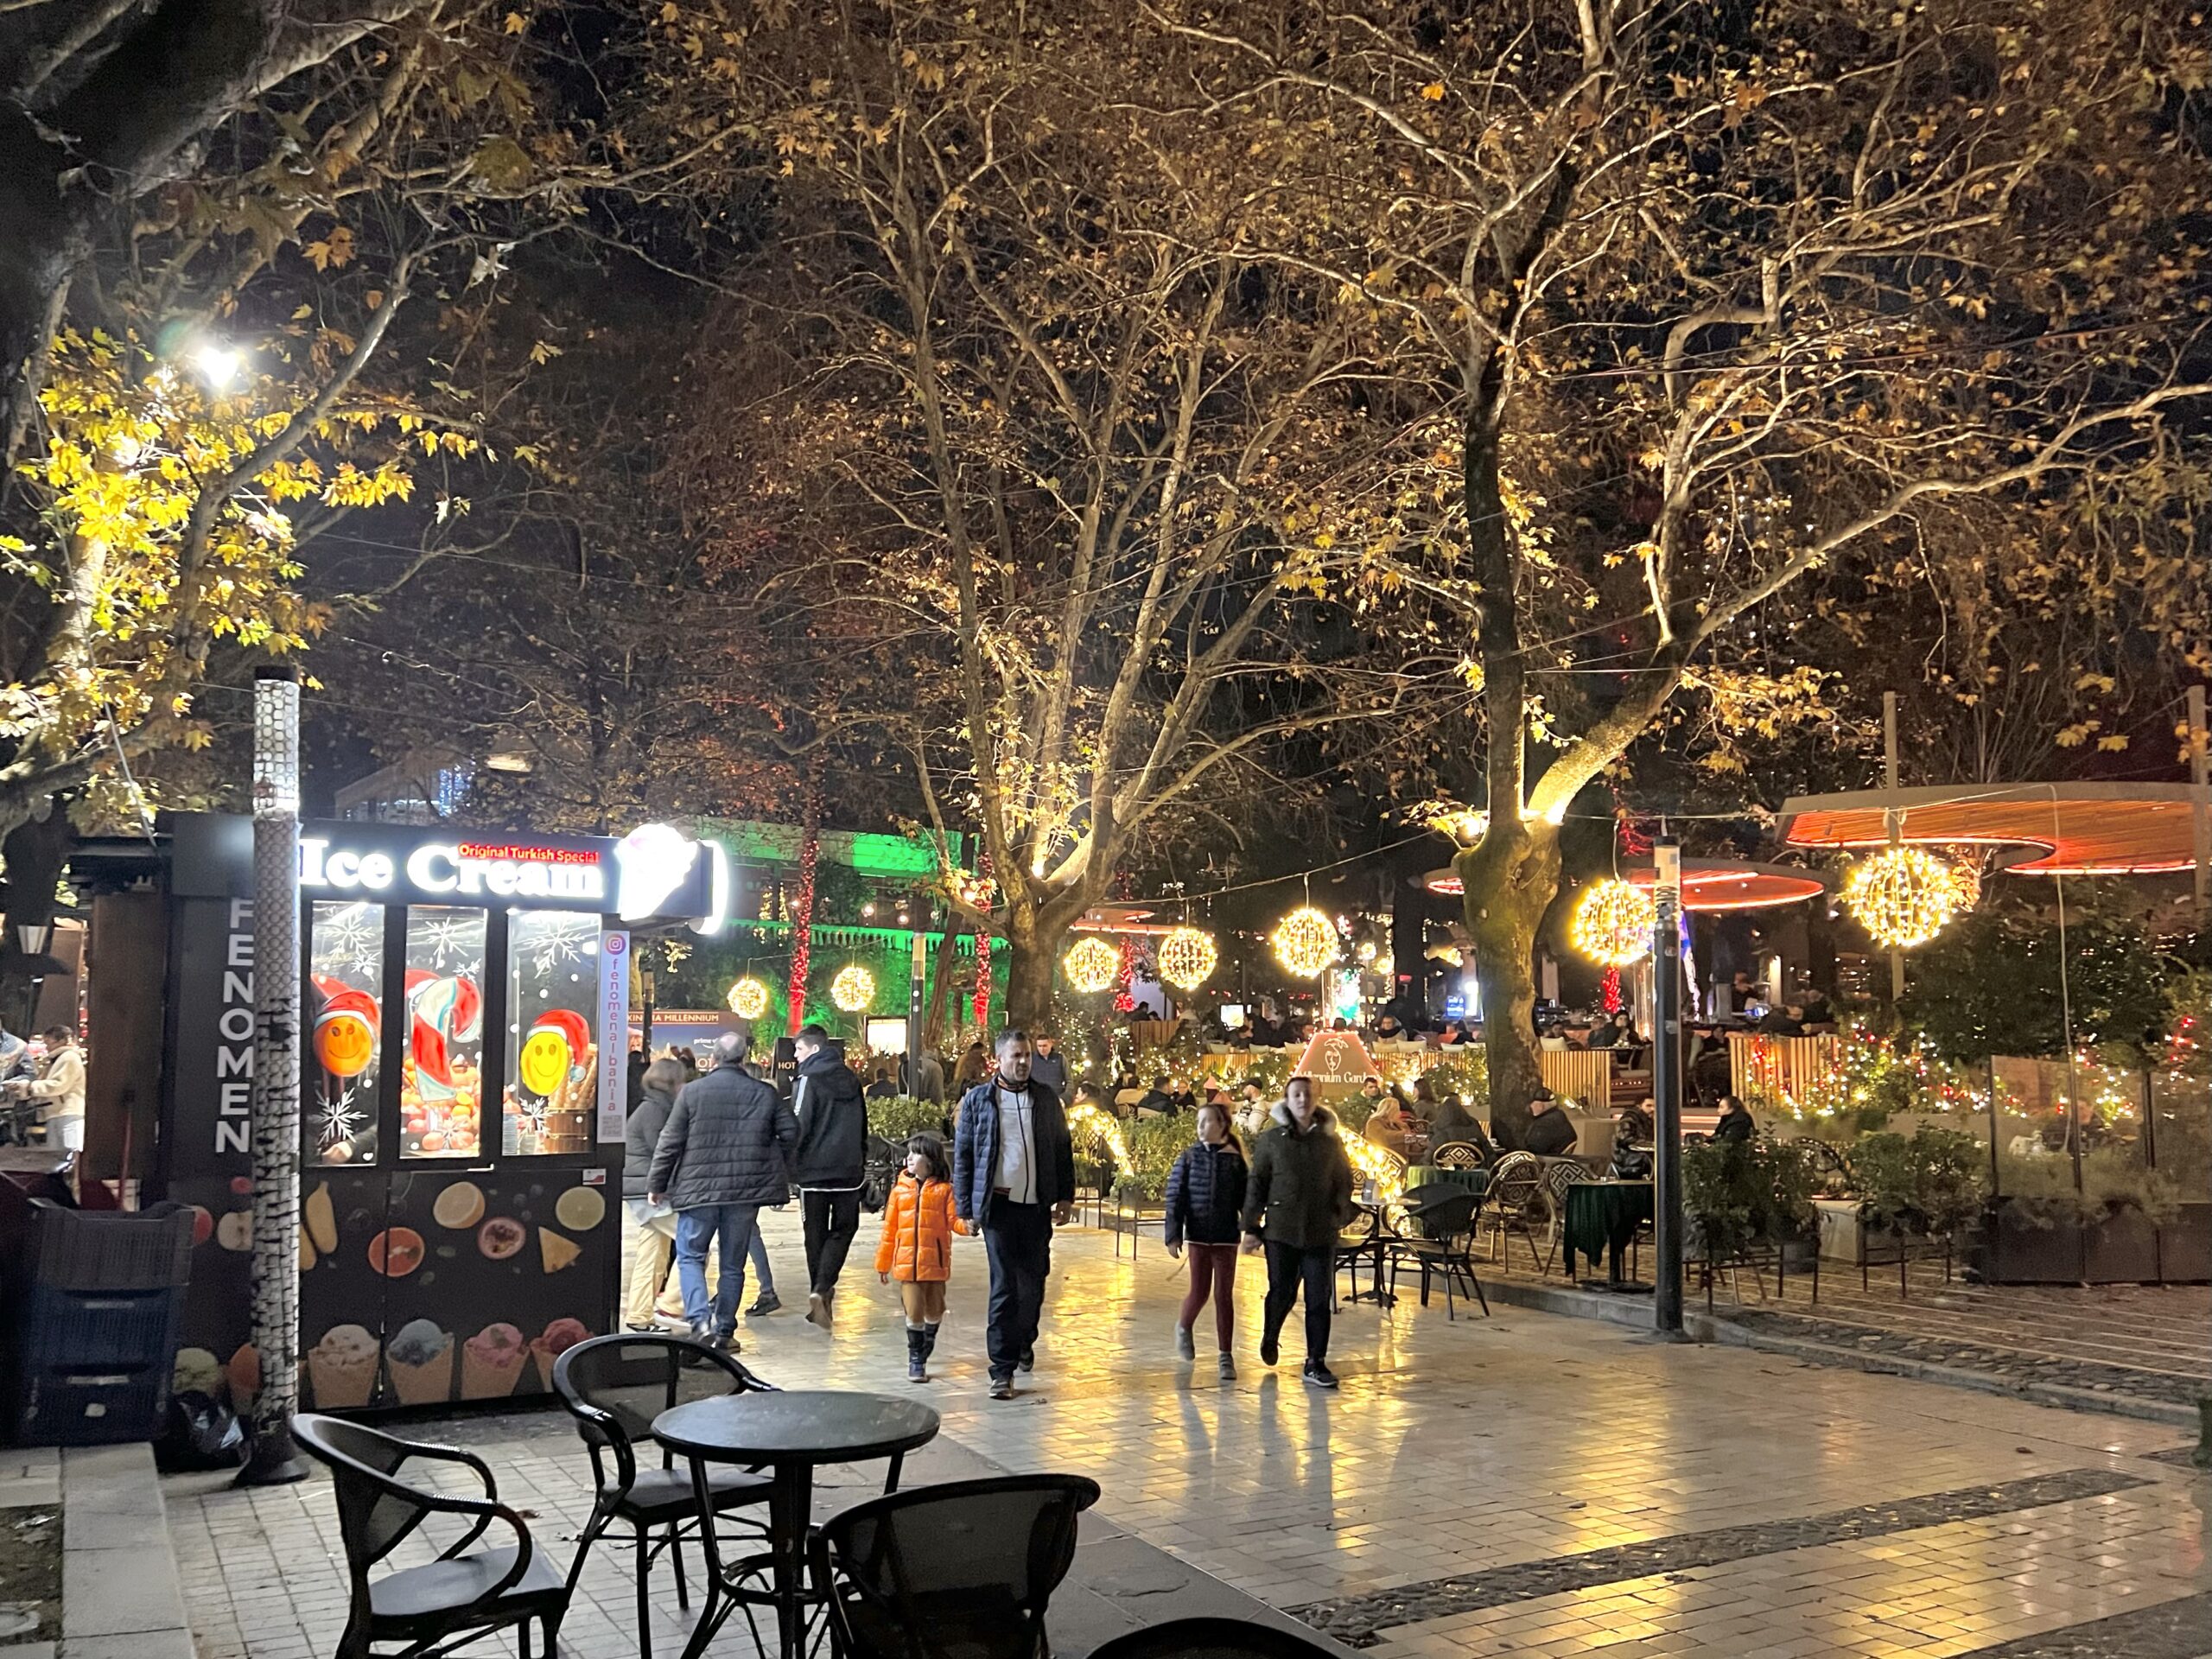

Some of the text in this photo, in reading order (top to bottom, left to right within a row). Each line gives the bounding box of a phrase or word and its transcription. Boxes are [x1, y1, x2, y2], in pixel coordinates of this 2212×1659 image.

[299, 838, 604, 899] Ice Cream
[458, 842, 600, 864] Original Turkish Special
[216, 898, 254, 1153] FENOMEN
[607, 958, 620, 1112] fenomenalbania
[664, 1013, 719, 1022] MILLENNIUM
[778, 1061, 797, 1070] HOT
